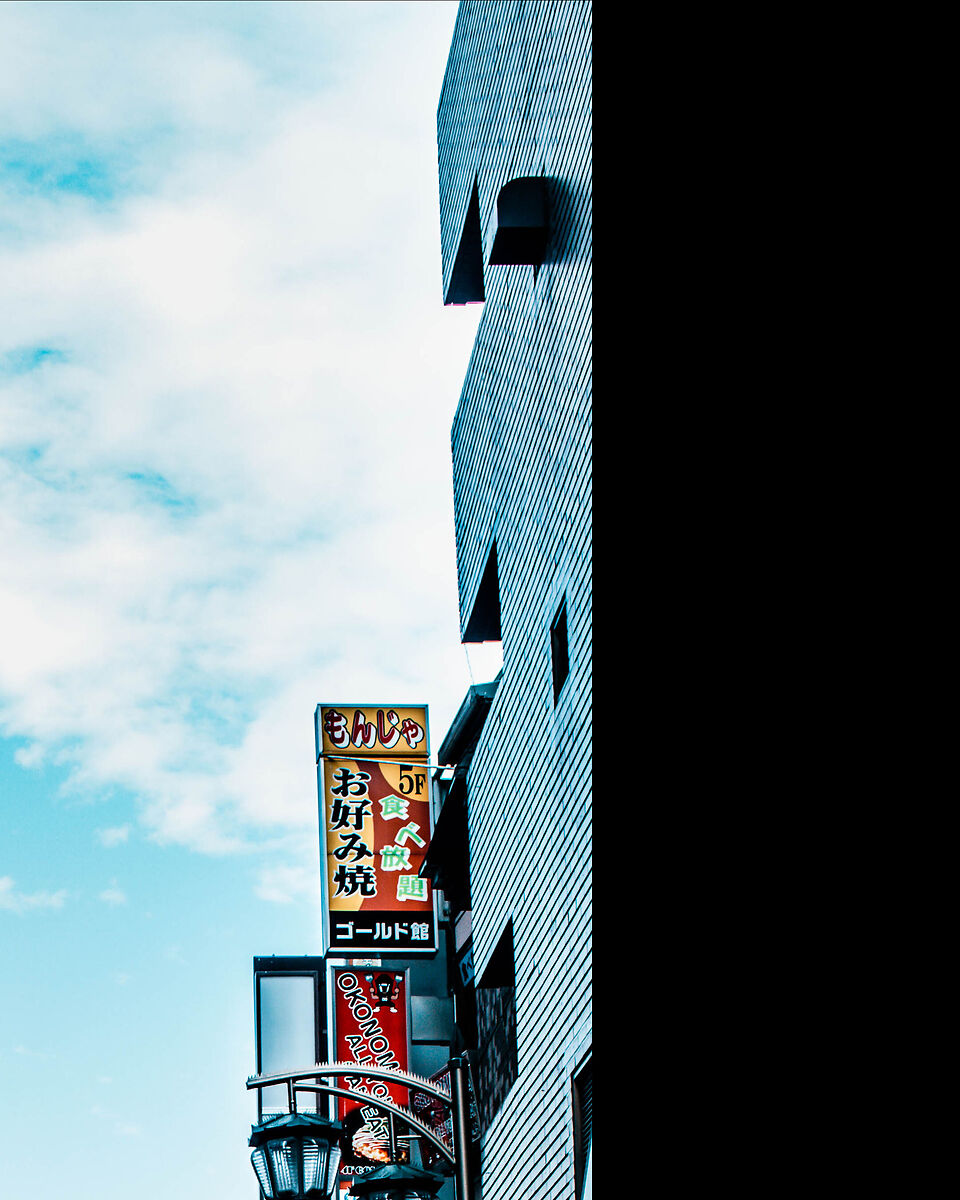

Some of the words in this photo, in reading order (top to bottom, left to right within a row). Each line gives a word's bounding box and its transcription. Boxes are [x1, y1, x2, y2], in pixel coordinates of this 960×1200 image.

[324, 709, 425, 749] もんじゃ
[399, 765, 426, 795] 5F
[331, 767, 377, 899] お好み焼
[378, 794, 428, 902] 食べ放題
[336, 921, 429, 941] ゴールド館
[360, 1105, 390, 1140] EAT
